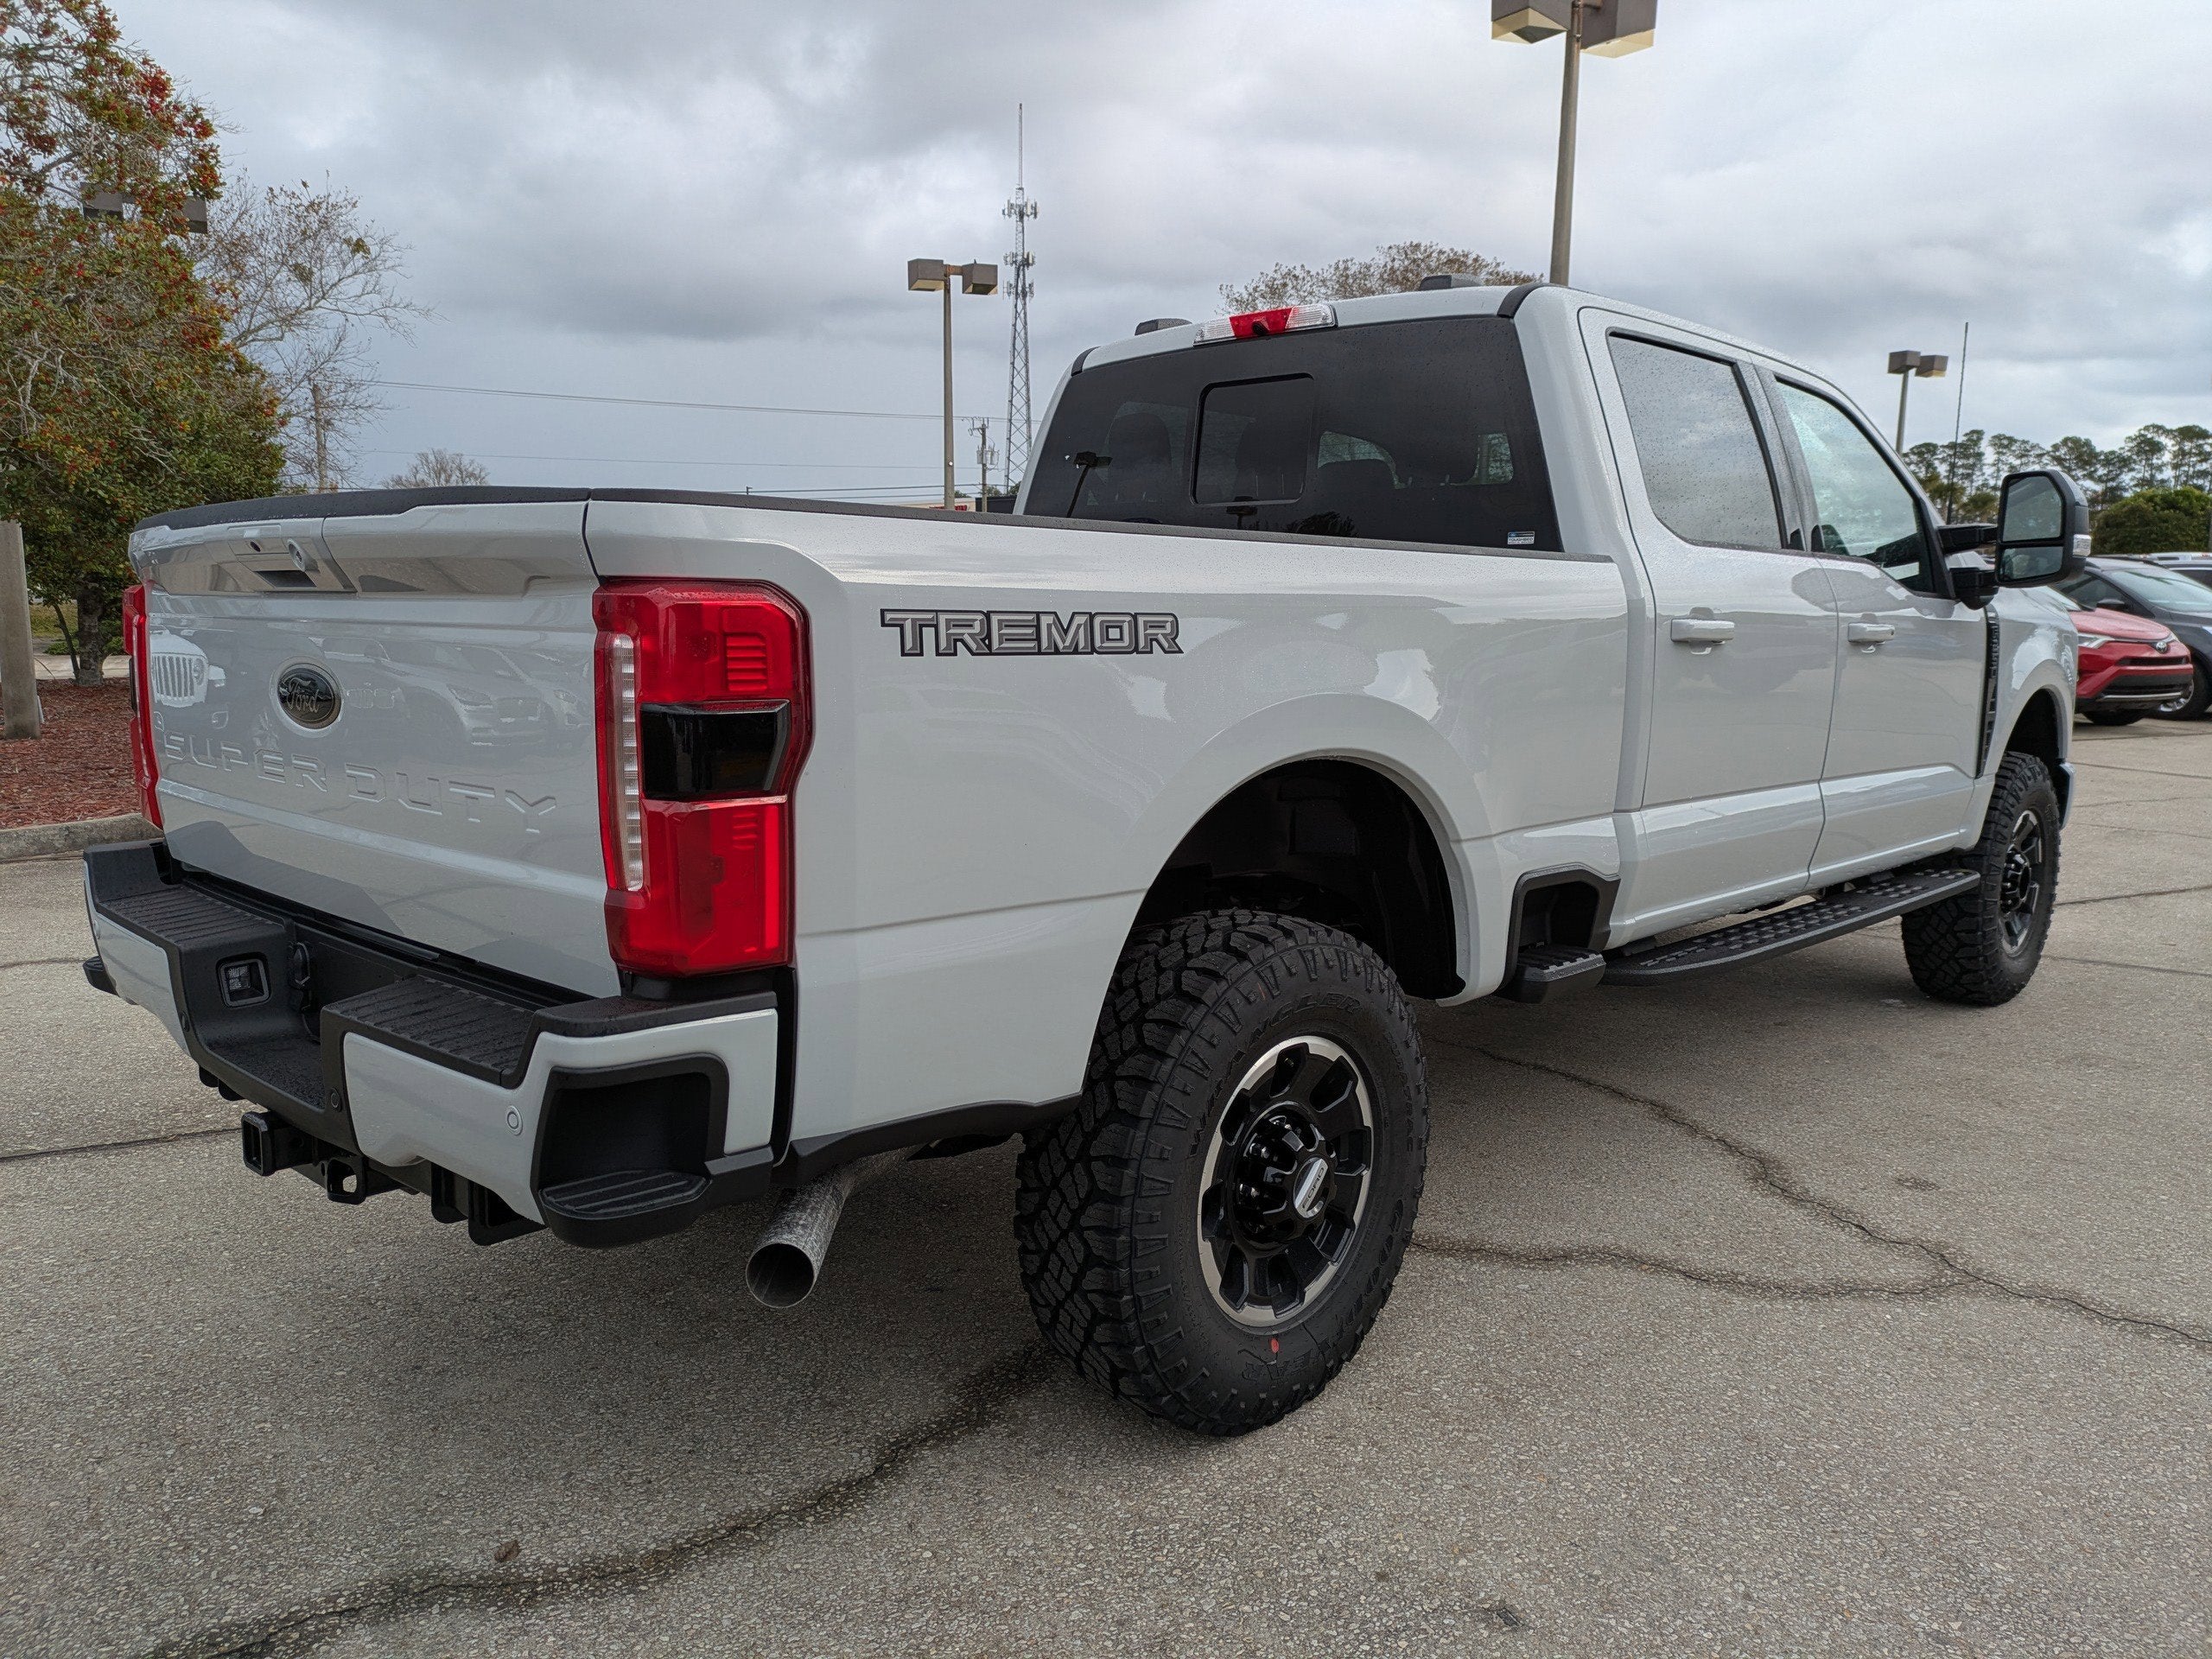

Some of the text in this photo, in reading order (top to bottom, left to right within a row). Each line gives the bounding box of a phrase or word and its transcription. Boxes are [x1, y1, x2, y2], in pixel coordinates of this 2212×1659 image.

[880, 608, 1184, 657] TREMOR
[285, 677, 321, 714] Ford
[162, 734, 557, 835] SUPER DUTY
[1301, 1166, 1325, 1209] FORD
